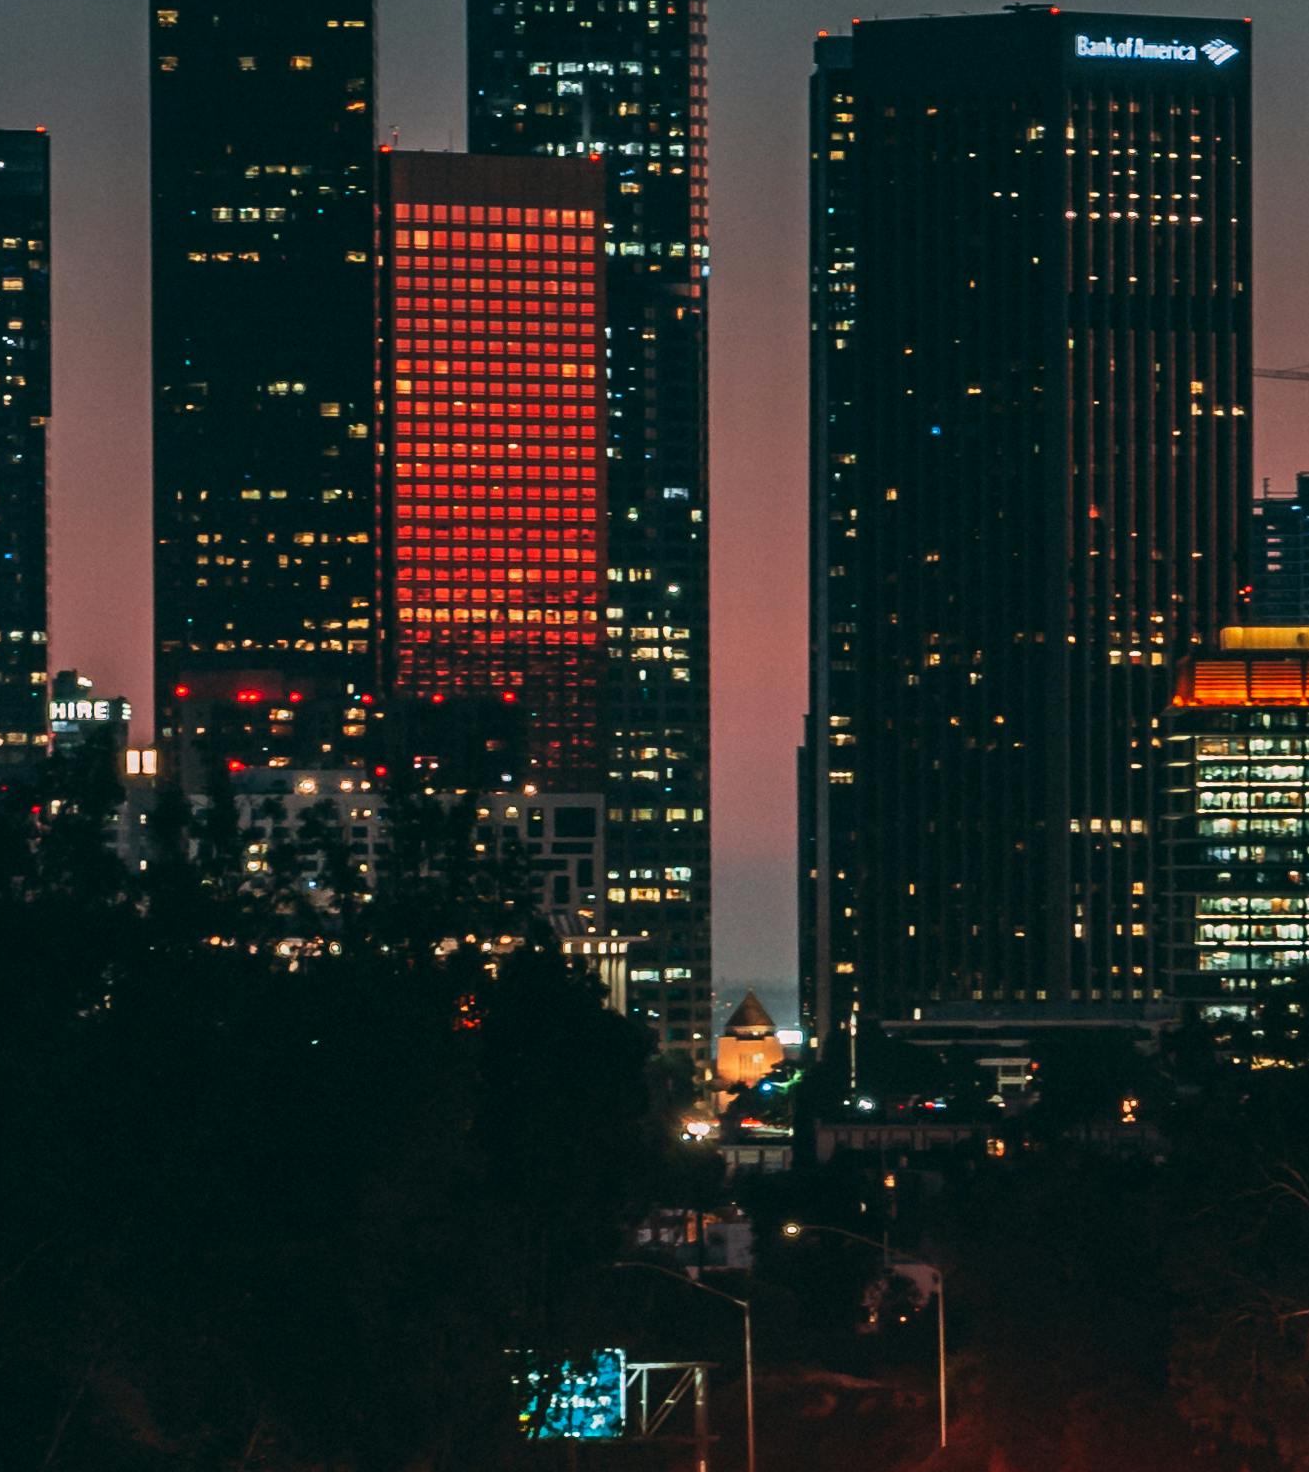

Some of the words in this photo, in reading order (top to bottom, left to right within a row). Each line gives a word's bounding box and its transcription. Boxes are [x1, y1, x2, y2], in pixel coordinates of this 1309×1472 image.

[1077, 35, 1116, 58] Bank
[1116, 37, 1133, 58] of
[1134, 38, 1196, 61] America
